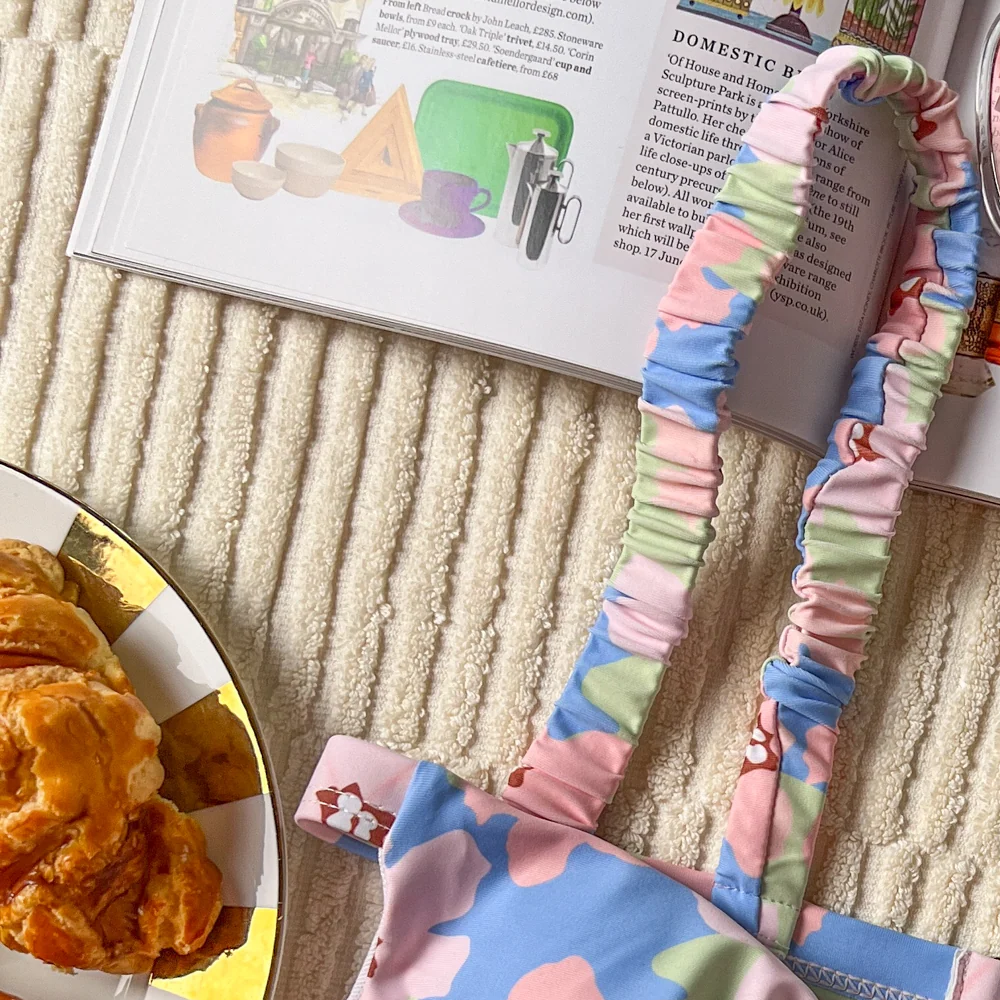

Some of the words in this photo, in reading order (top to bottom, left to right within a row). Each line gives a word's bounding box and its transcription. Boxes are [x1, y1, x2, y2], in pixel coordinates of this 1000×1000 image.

[379, 9, 405, 22] bowls,
[406, 14, 425, 26] from
[426, 18, 437, 27] £9
[437, 22, 457, 32] each.
[506, 35, 534, 48] trivet,
[535, 41, 565, 55] £14.50.
[406, 1, 422, 11] left
[422, 3, 447, 16] Bread
[446, 10, 471, 20] crock
[471, 13, 482, 24] by
[482, 15, 503, 27] John
[504, 20, 531, 34] Leach,
[532, 26, 555, 39] £285.
[557, 32, 604, 50] Stoneware
[372, 37, 400, 48] saucer,
[402, 41, 417, 51] £16.
[417, 43, 477, 63] Stainless-steel
[476, 57, 518, 73] cafetiere,
[519, 65, 541, 77] from
[541, 70, 559, 81] £68
[403, 28, 441, 42] plywood
[441, 35, 460, 47] tray,
[461, 39, 490, 52] £29.50.
[555, 61, 573, 72] cup
[573, 65, 592, 75] and
[672, 29, 776, 72] DOMESTIC
[685, 58, 721, 78] House
[722, 73, 745, 85] and
[661, 69, 716, 93] Sculpture
[717, 85, 745, 103] Park
[653, 99, 699, 122] Pattullo.
[702, 113, 725, 129] Her
[657, 87, 733, 115] screen-prints
[648, 115, 700, 138] domestic
[701, 130, 720, 144] life
[654, 132, 705, 157] Victorian
[828, 144, 855, 164] Alice
[639, 145, 658, 159] life
[659, 153, 713, 176] close-ups
[631, 175, 670, 197] below).
[672, 189, 690, 202] All
[815, 174, 845, 193] range
[846, 186, 871, 207] from
[626, 194, 676, 214] available
[839, 202, 860, 218] still
[618, 224, 651, 241] which
[654, 234, 675, 247] will
[832, 213, 854, 232] 19th
[613, 238, 641, 255] shop.
[644, 247, 658, 258] 17
[806, 254, 852, 282] designed
[807, 272, 837, 291] range
[770, 288, 828, 322] (ysp.co.uk).
